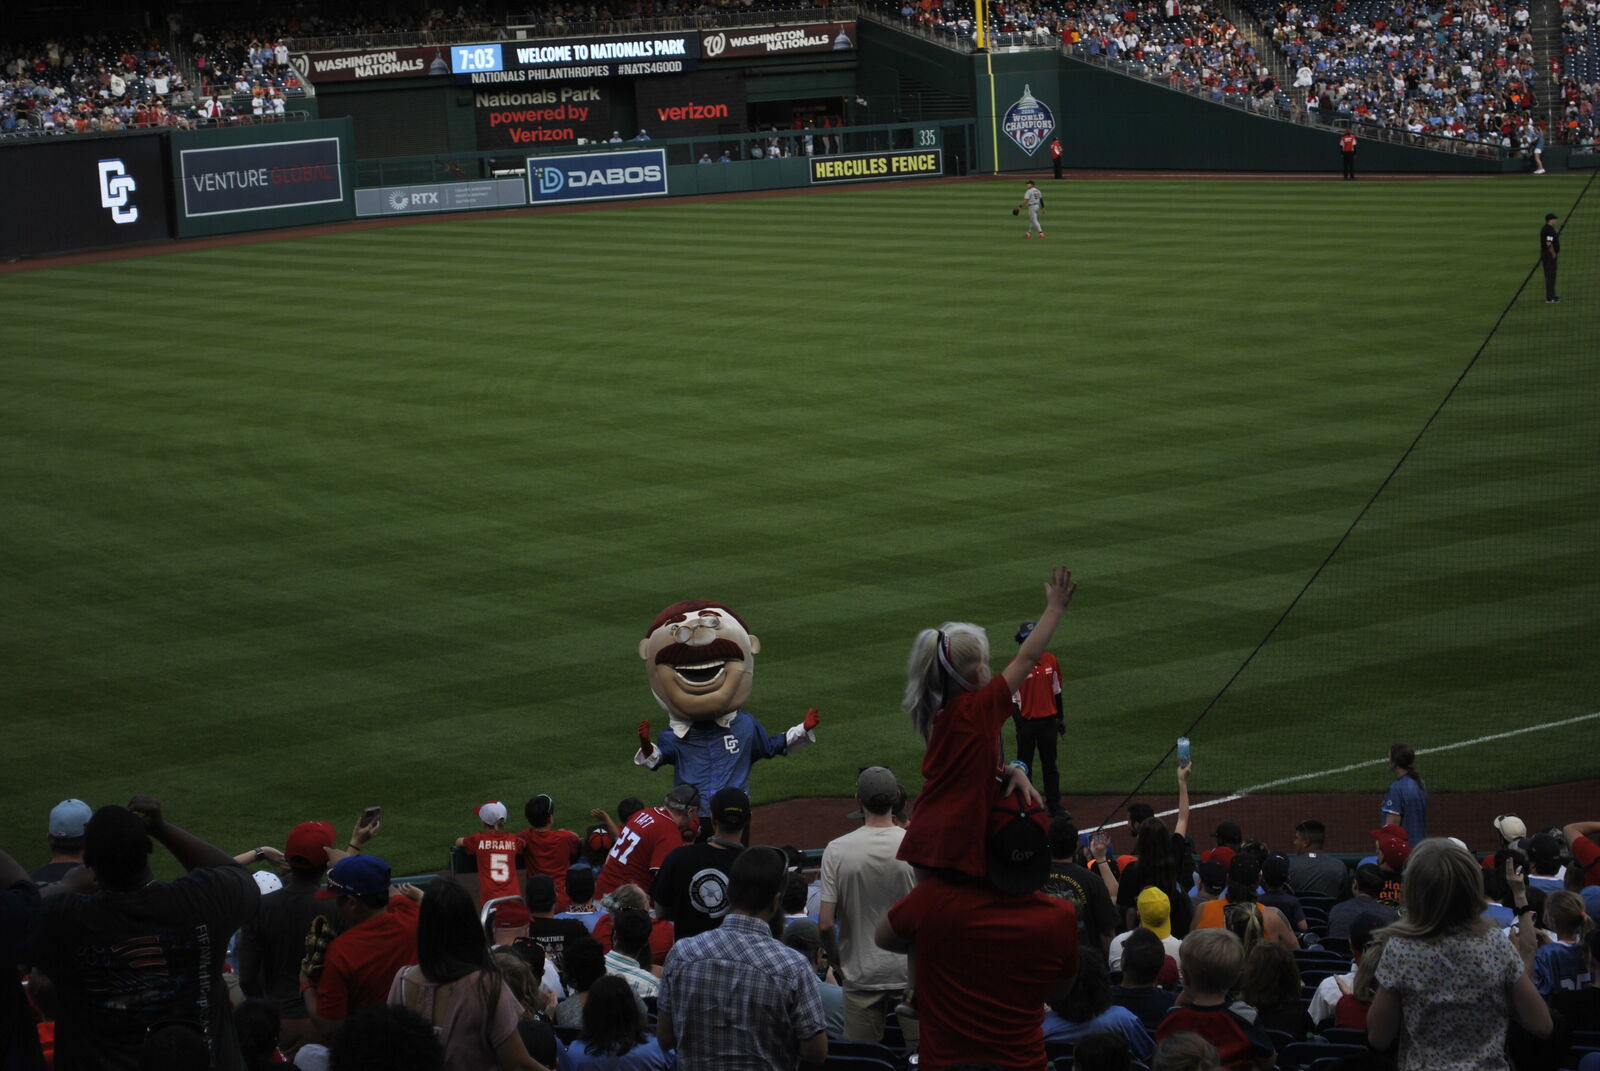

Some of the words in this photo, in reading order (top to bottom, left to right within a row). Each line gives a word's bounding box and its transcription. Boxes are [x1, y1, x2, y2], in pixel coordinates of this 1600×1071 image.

[730, 30, 805, 47] WASHINGTON
[766, 34, 828, 52] NATIONALS
[314, 51, 397, 72] WASHINGTON
[460, 48, 494, 70] 7:03
[516, 46, 572, 64] WELCOME
[573, 44, 588, 60] TO
[590, 40, 654, 60] NATIONALS
[654, 39, 686, 55] PARK
[354, 59, 424, 78] NATIONALS
[472, 71, 526, 84] NATIONALS
[528, 66, 610, 81] PHILANTHROPIES
[618, 61, 682, 76] #NATS4GOOD
[476, 88, 557, 108] Nationals
[561, 86, 600, 102] Park
[490, 104, 565, 128] powered
[568, 104, 590, 122] by
[657, 102, 728, 120] verizon
[1012, 113, 1044, 122] WORLD
[509, 126, 574, 143] Verizon
[1006, 120, 1052, 131] CHAMPIONS
[919, 129, 936, 146] 335
[568, 165, 661, 188] DABOS
[816, 158, 888, 178] HERCULES
[892, 154, 936, 172] FENCE
[192, 168, 268, 192] VENTURE
[271, 164, 333, 184] GLOBAL
[411, 192, 439, 205] RTX
[634, 812, 655, 828] TAFT
[610, 826, 641, 864] 27
[490, 853, 509, 882] 5
